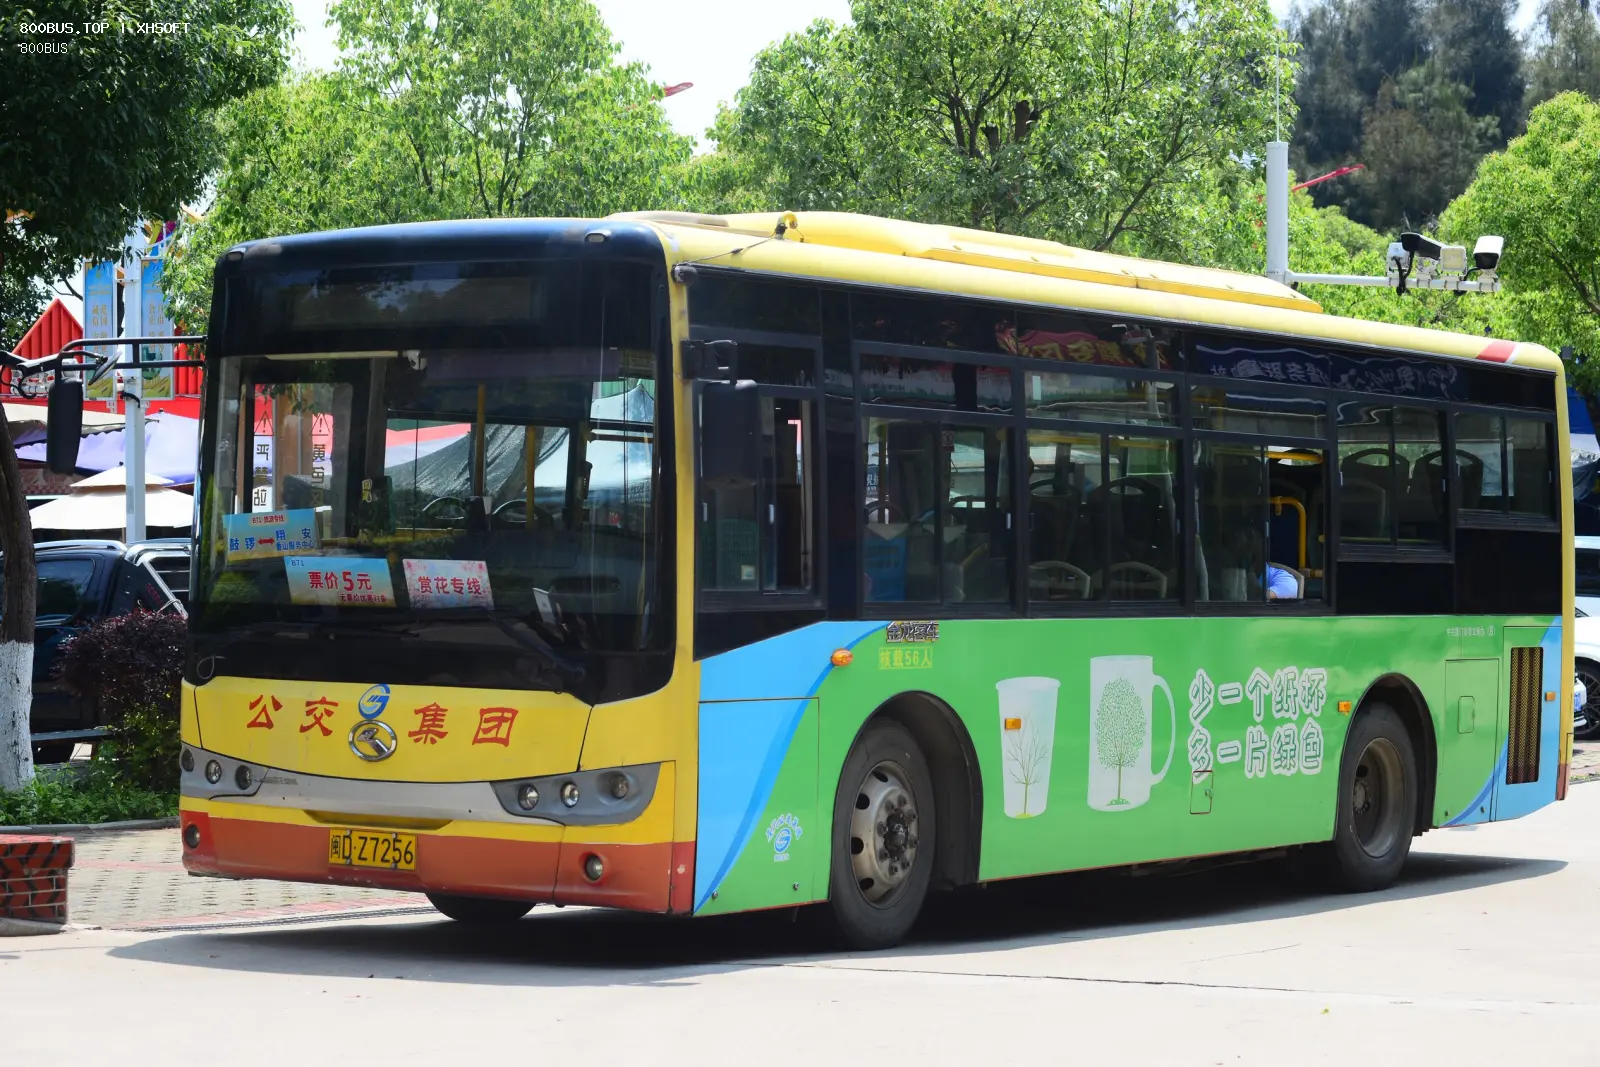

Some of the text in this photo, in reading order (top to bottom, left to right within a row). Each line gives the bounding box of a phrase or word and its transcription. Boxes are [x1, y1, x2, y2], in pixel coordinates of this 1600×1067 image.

[229, 536, 255, 552] 鼓锣
[291, 559, 305, 567] B71
[417, 576, 483, 596] 赏花专线
[1189, 666, 1327, 722] 少一个纸杯
[1188, 717, 1324, 784] 多一片绿色
